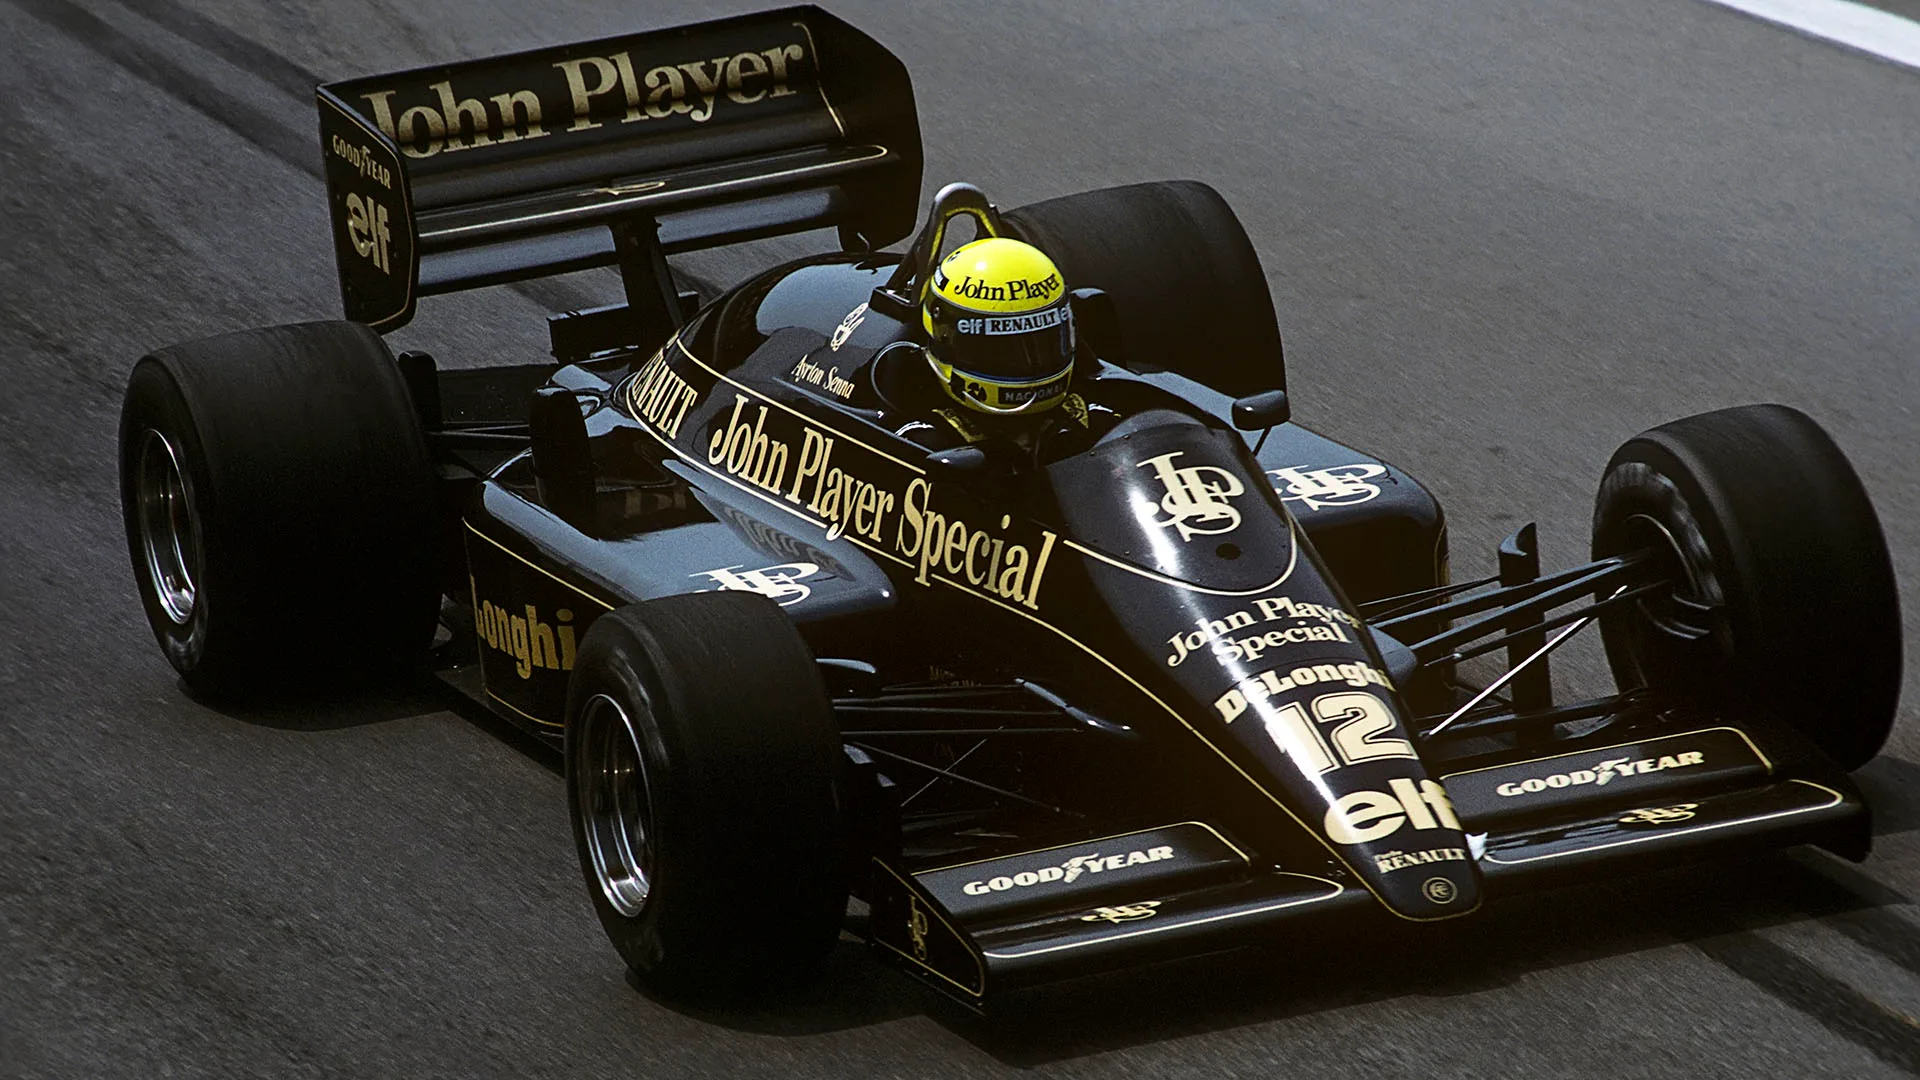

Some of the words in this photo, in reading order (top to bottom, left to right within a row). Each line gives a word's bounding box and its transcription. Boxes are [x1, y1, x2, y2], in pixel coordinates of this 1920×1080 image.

[361, 82, 550, 159] John
[553, 44, 802, 133] Player
[346, 192, 391, 275] elf
[954, 276, 1006, 301] John
[1006, 273, 1060, 299] Player
[957, 318, 983, 334] elf
[990, 311, 1057, 332] RENAULT
[791, 354, 825, 385] Ayrton
[822, 366, 856, 400] Senna
[708, 393, 791, 496] John
[785, 426, 894, 541] Player
[897, 477, 1057, 610] Special
[1167, 611, 1256, 667] John
[1211, 620, 1353, 665] Special
[1268, 691, 1420, 776] 12
[1496, 750, 1706, 798] GOODYEAR
[1323, 778, 1464, 845] elf
[963, 845, 1176, 896] GOODYEAR
[1376, 848, 1467, 874] RENAULT
